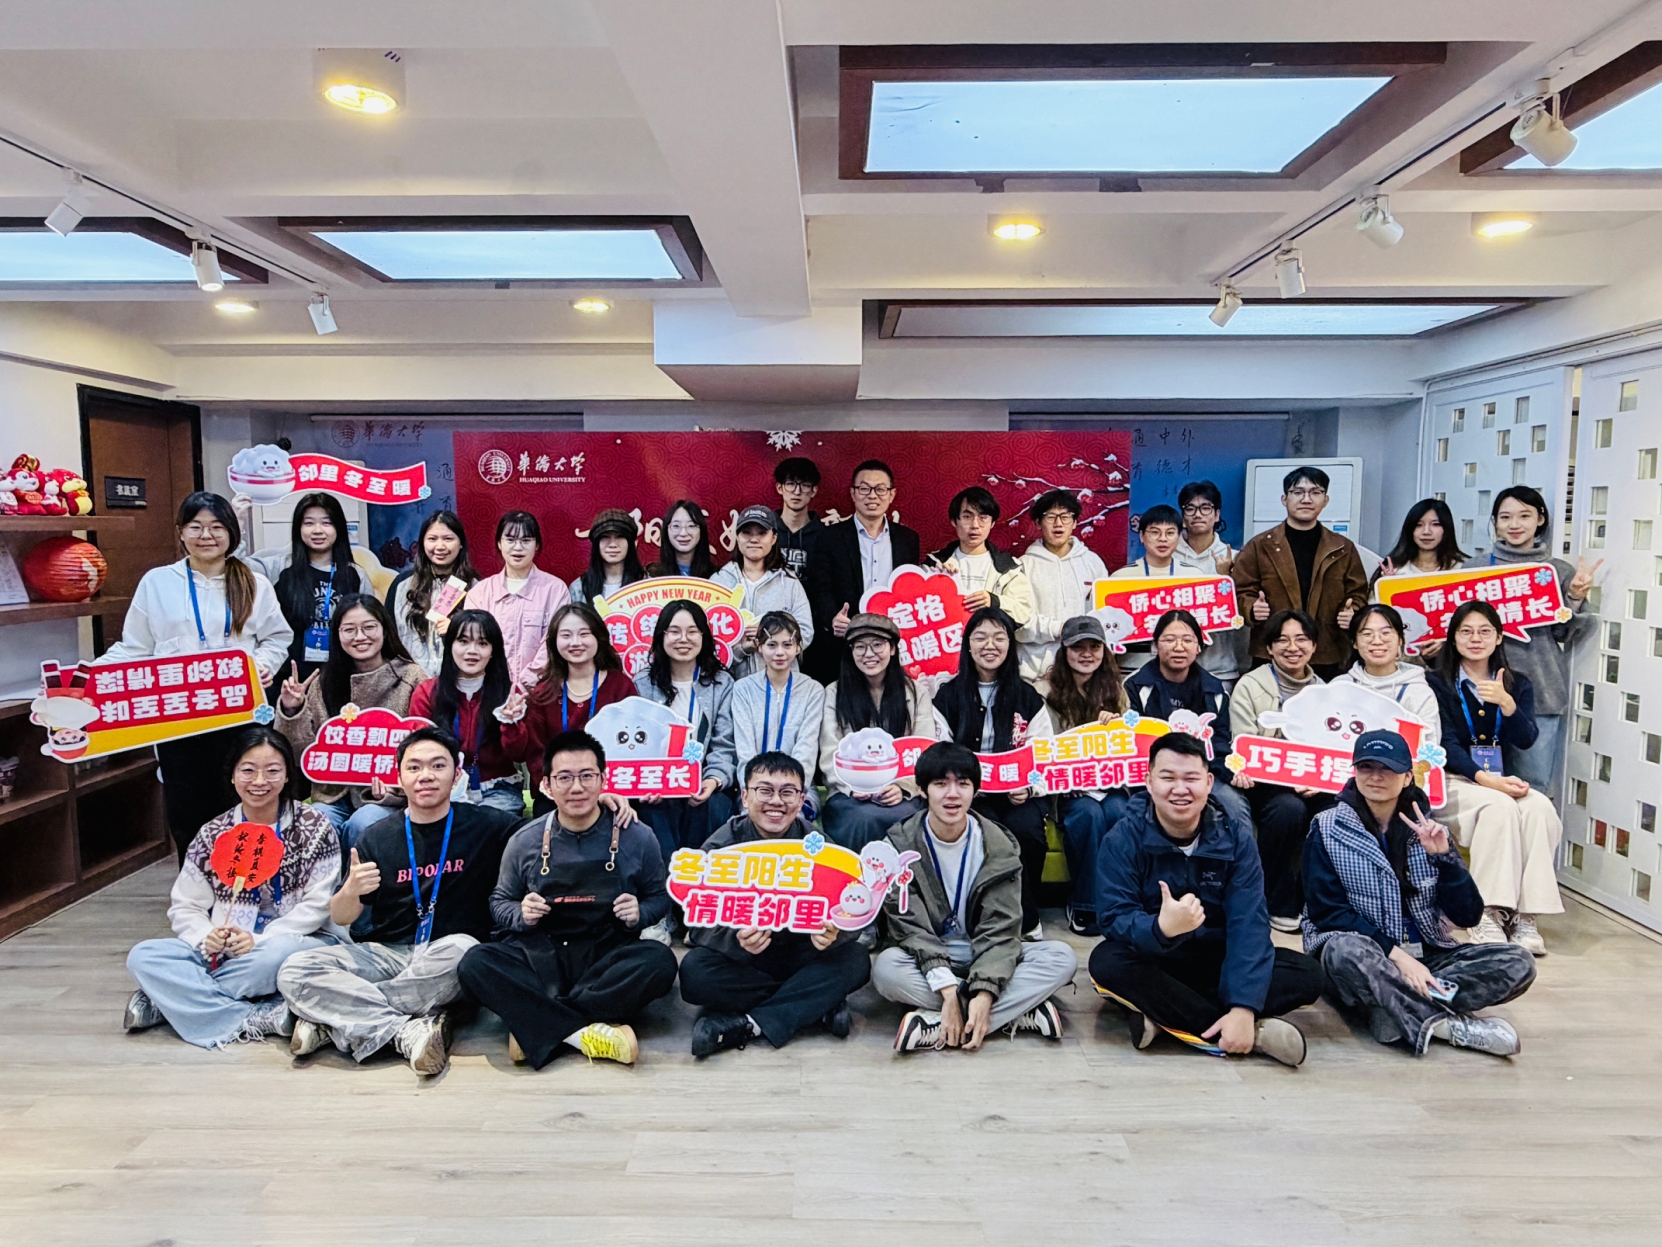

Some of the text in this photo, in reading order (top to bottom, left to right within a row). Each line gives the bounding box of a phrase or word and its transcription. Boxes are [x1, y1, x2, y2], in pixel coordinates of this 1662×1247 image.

[298, 463, 412, 496] 邻里冬至暖
[627, 588, 712, 609] HAPPY NEW YEAR
[1128, 584, 1216, 614] 侨心相聚
[1419, 574, 1533, 613] 侨心相聚
[887, 594, 946, 629] 定格
[1144, 604, 1232, 634] 冬情长
[607, 612, 734, 646] 传统化
[94, 656, 245, 695] 叙邻里情深
[100, 684, 248, 723] 品冬至至味
[325, 724, 416, 748] 饺香飘四
[1032, 731, 1135, 761] 冬至阳生
[307, 751, 398, 775] 汤圆暖侨
[604, 765, 691, 790] 冬至长
[1045, 761, 1149, 792] 情暖邻里
[672, 852, 811, 888] 冬至阳生
[686, 893, 826, 930] 情暖邻里
